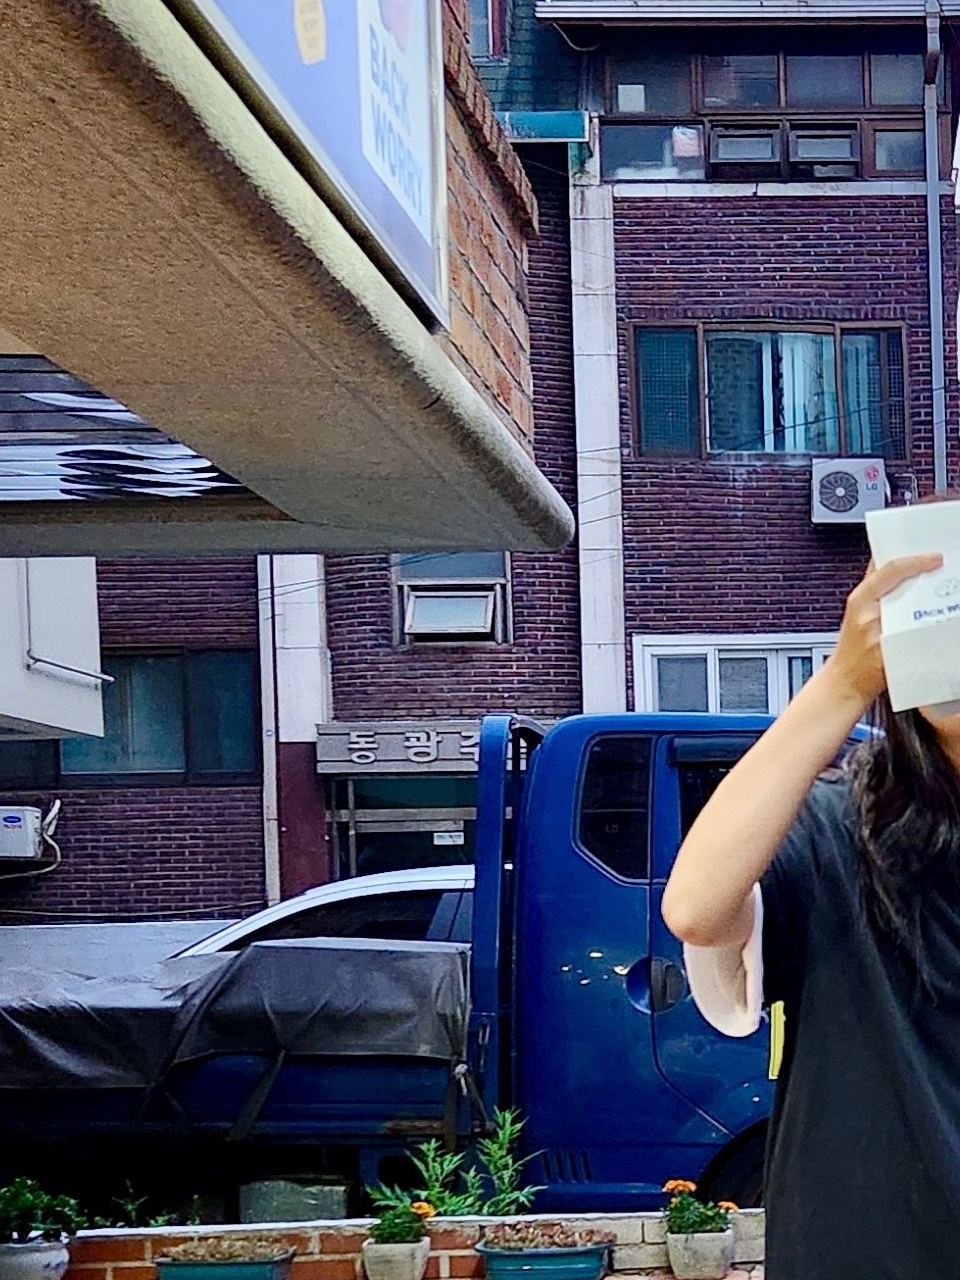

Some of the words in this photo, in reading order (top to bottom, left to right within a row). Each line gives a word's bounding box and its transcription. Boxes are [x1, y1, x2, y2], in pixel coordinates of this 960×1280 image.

[370, 23, 411, 136] BACK
[371, 93, 423, 216] WORRY
[865, 482, 879, 491] LG
